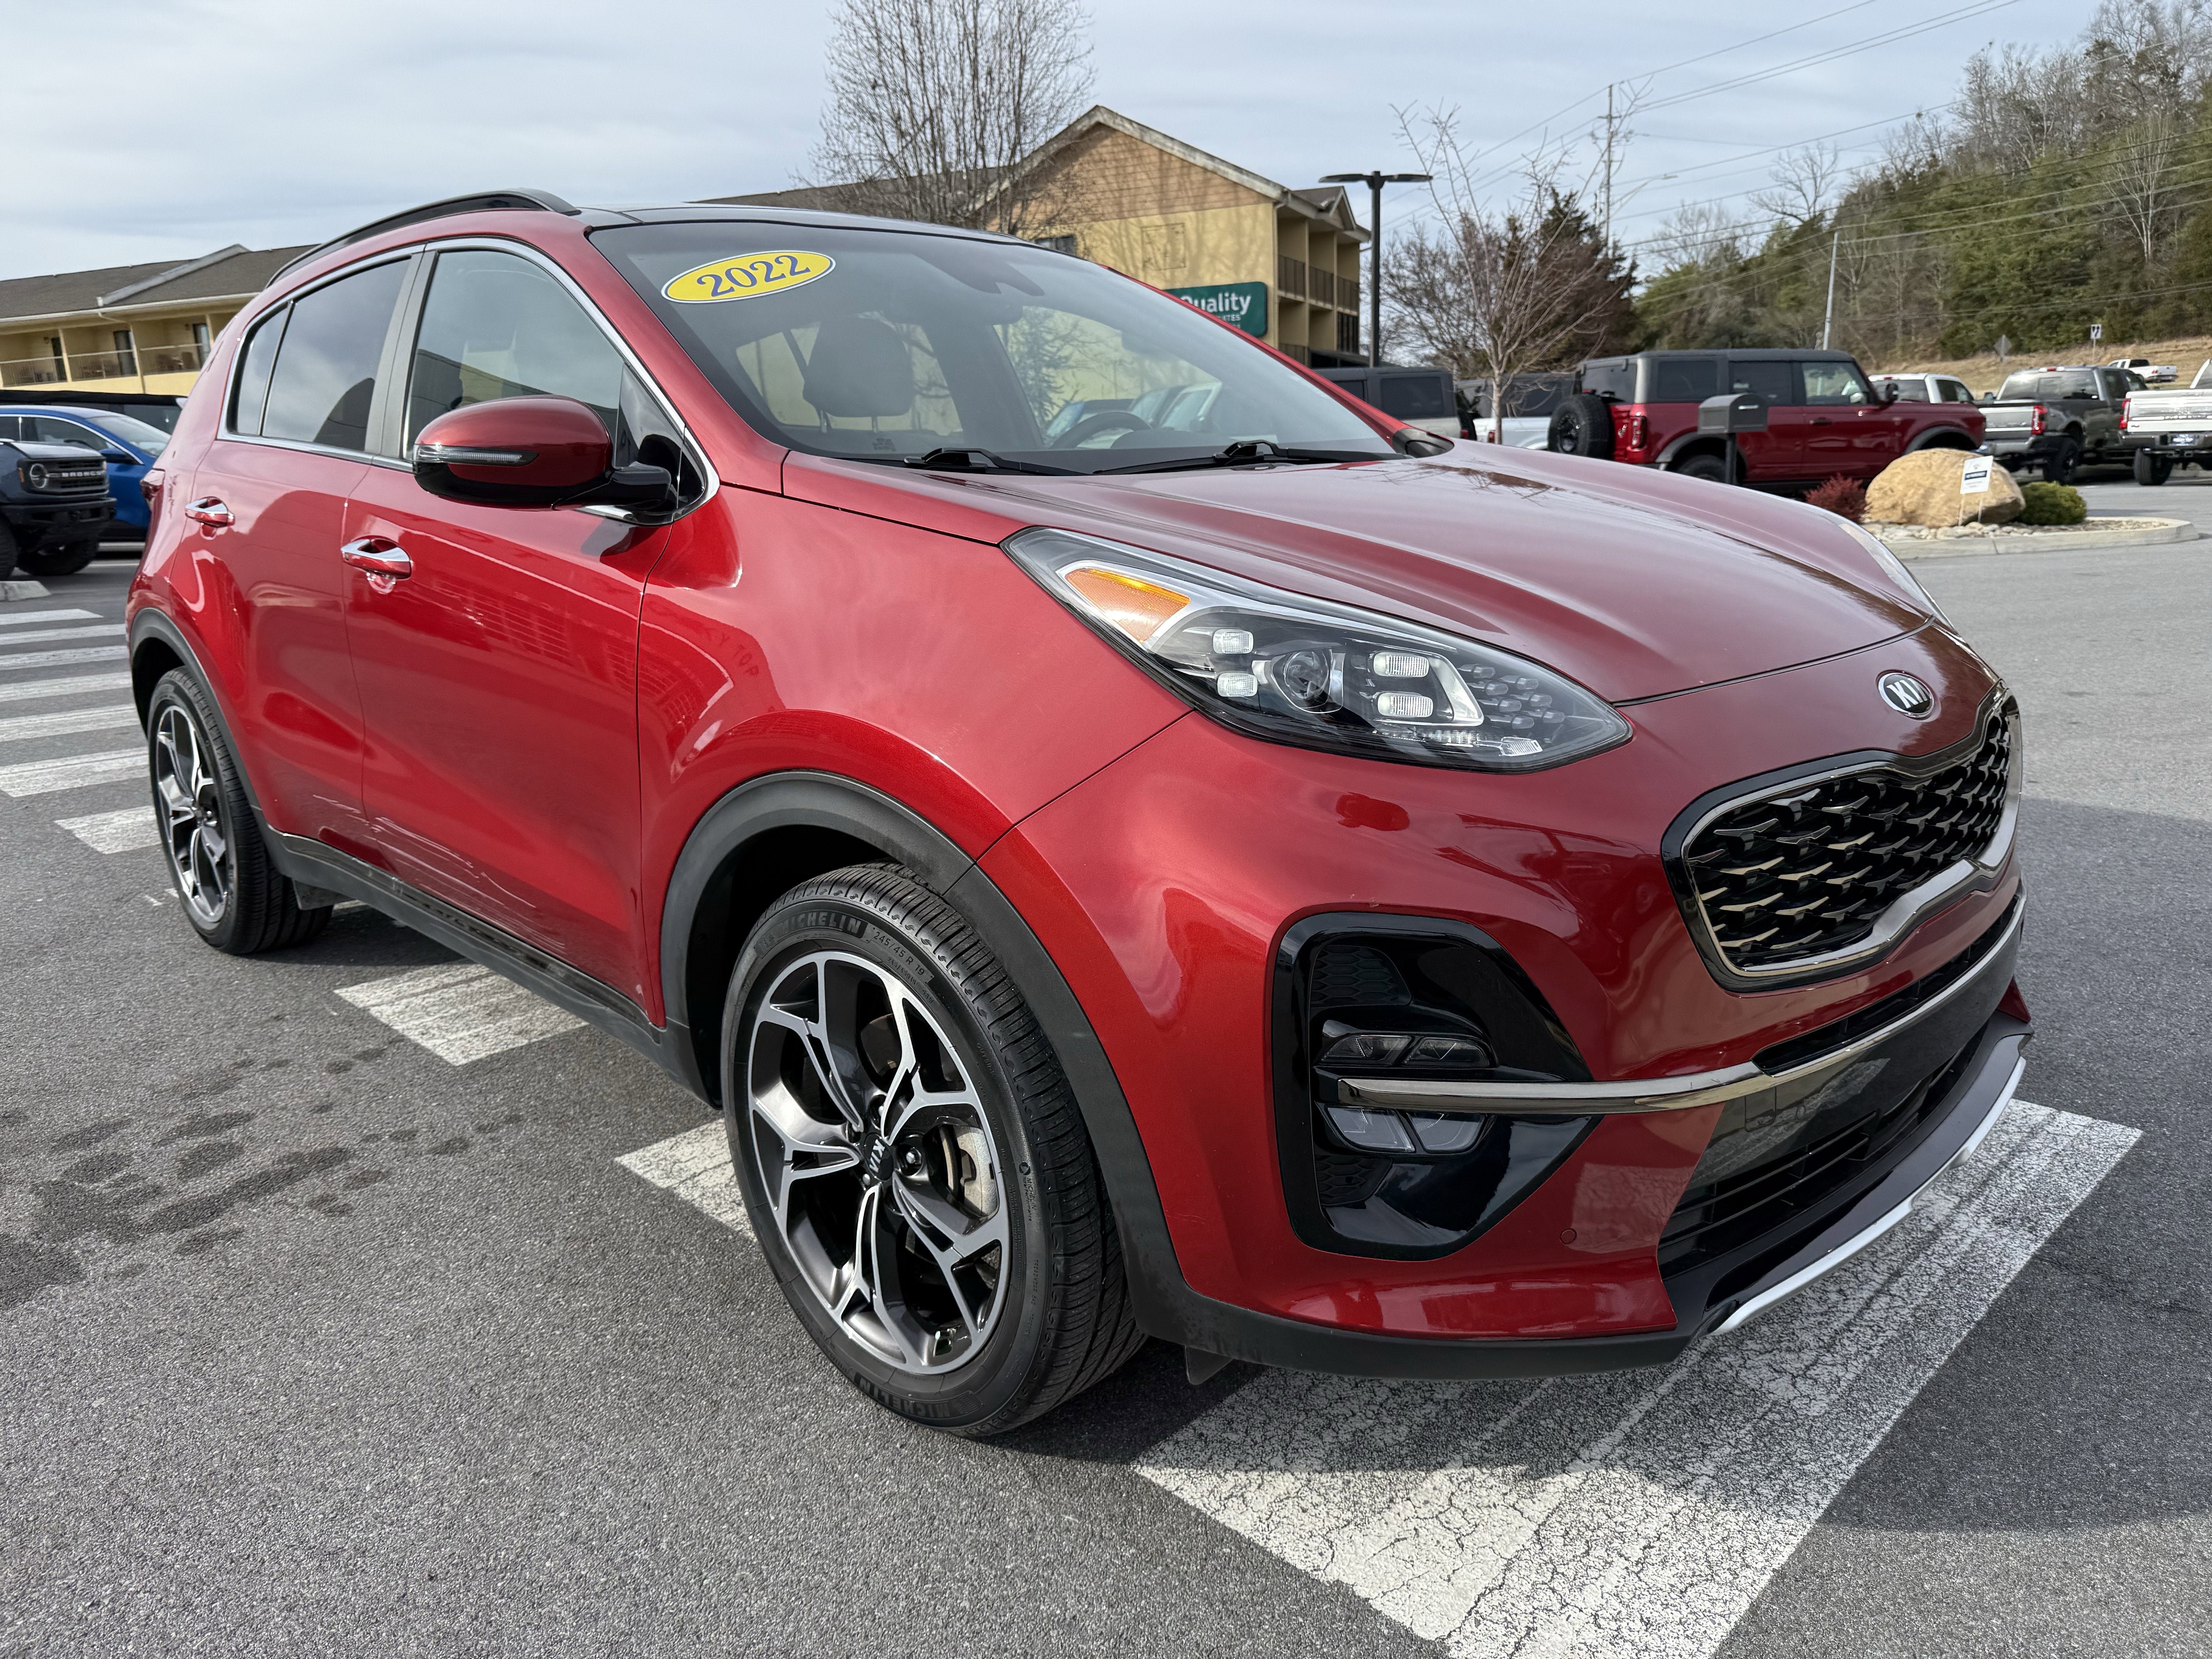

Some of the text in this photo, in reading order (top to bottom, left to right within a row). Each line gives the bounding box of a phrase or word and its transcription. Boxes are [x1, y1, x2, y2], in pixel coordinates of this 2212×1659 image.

[696, 254, 811, 297] 2022
[1886, 677, 1932, 709] KIA
[780, 911, 862, 934] MICHELIN
[873, 931, 925, 975] 245/45 R 19
[869, 1139, 886, 1173] KIA
[1027, 1177, 1037, 1211] MICHELIN
[859, 1377, 951, 1419] MICHELIN
